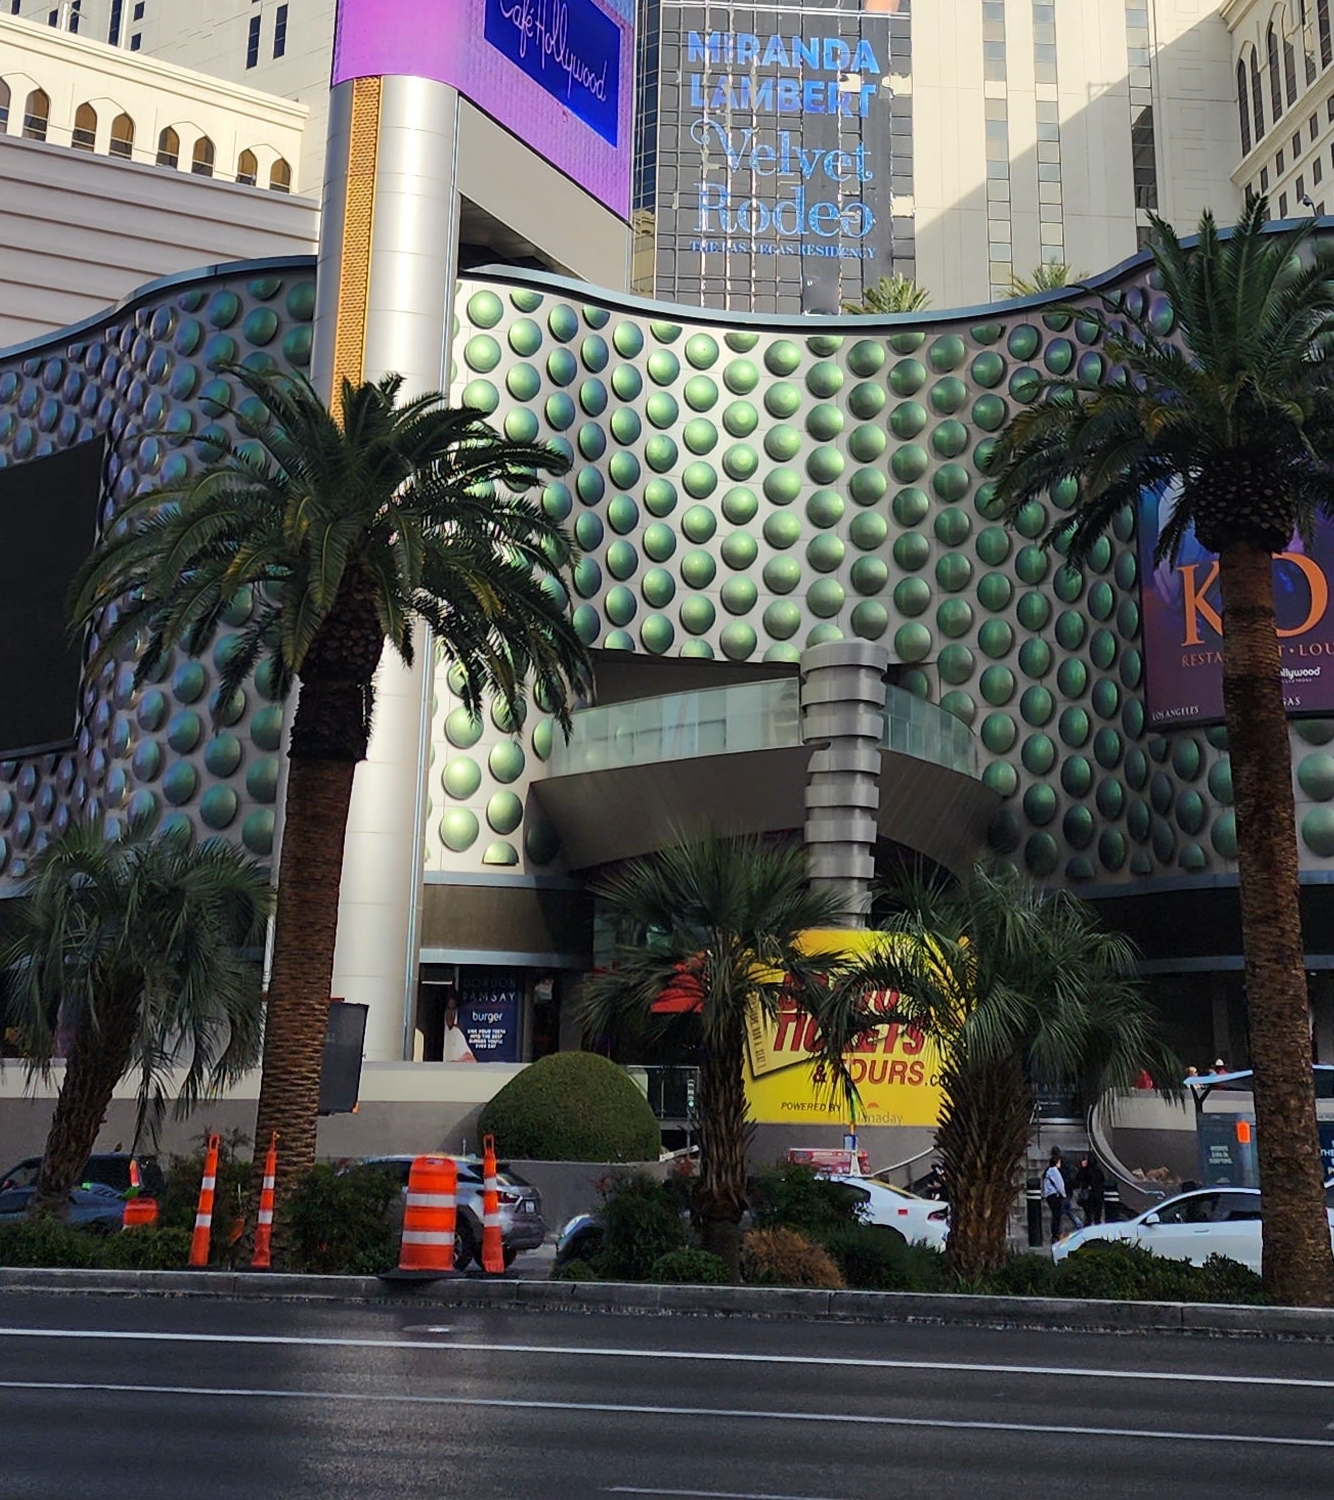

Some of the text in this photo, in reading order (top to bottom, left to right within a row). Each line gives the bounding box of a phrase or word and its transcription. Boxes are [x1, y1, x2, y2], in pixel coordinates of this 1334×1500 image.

[687, 30, 881, 74] MIRANDA
[689, 73, 877, 118] LAMBERT
[690, 118, 873, 182] Velvet
[693, 182, 875, 238] Rodeo
[689, 240, 719, 253] THE
[722, 242, 747, 255] LAS
[798, 244, 876, 259] RESIDENCY
[472, 1011, 503, 1024] burger
[781, 1101, 826, 1112] POWERED
